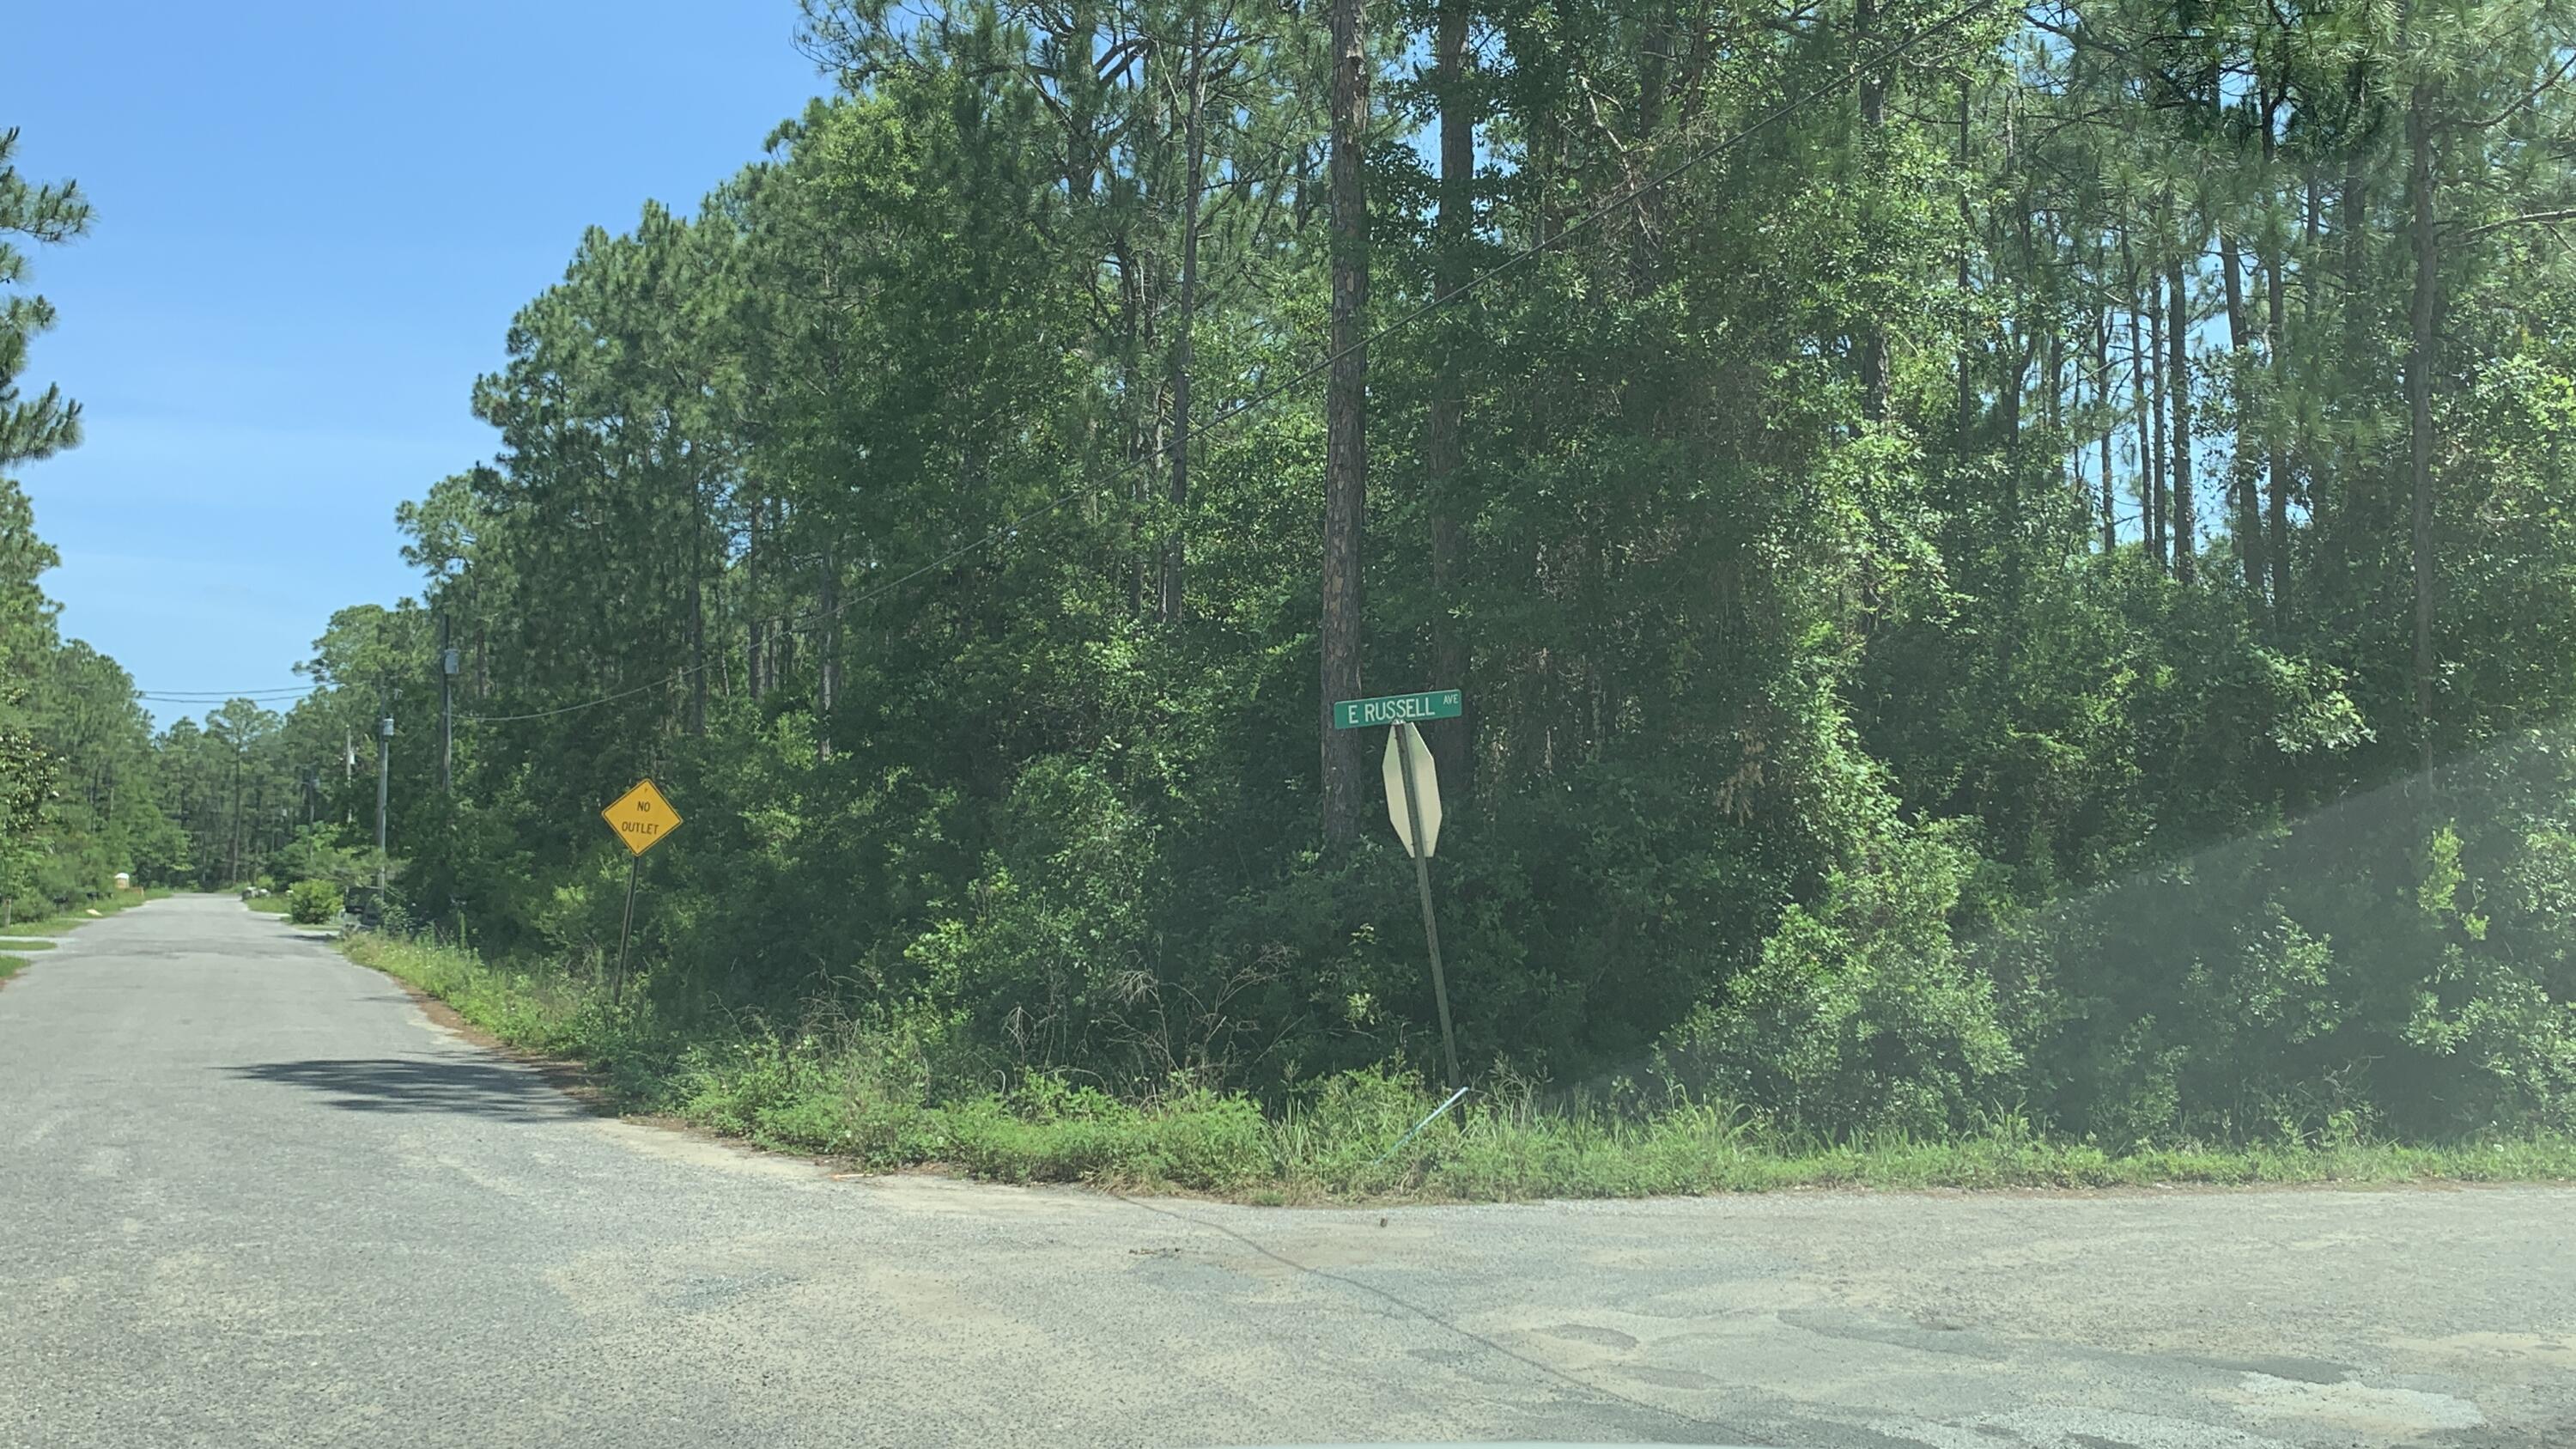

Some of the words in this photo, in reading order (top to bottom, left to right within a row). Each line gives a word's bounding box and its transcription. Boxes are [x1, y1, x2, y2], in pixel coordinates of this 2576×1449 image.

[1348, 704, 1358, 724] E
[1364, 697, 1436, 722] RUSSELL
[1443, 693, 1459, 705] AVE
[636, 801, 651, 813] NO
[621, 821, 659, 835] OUTLET
